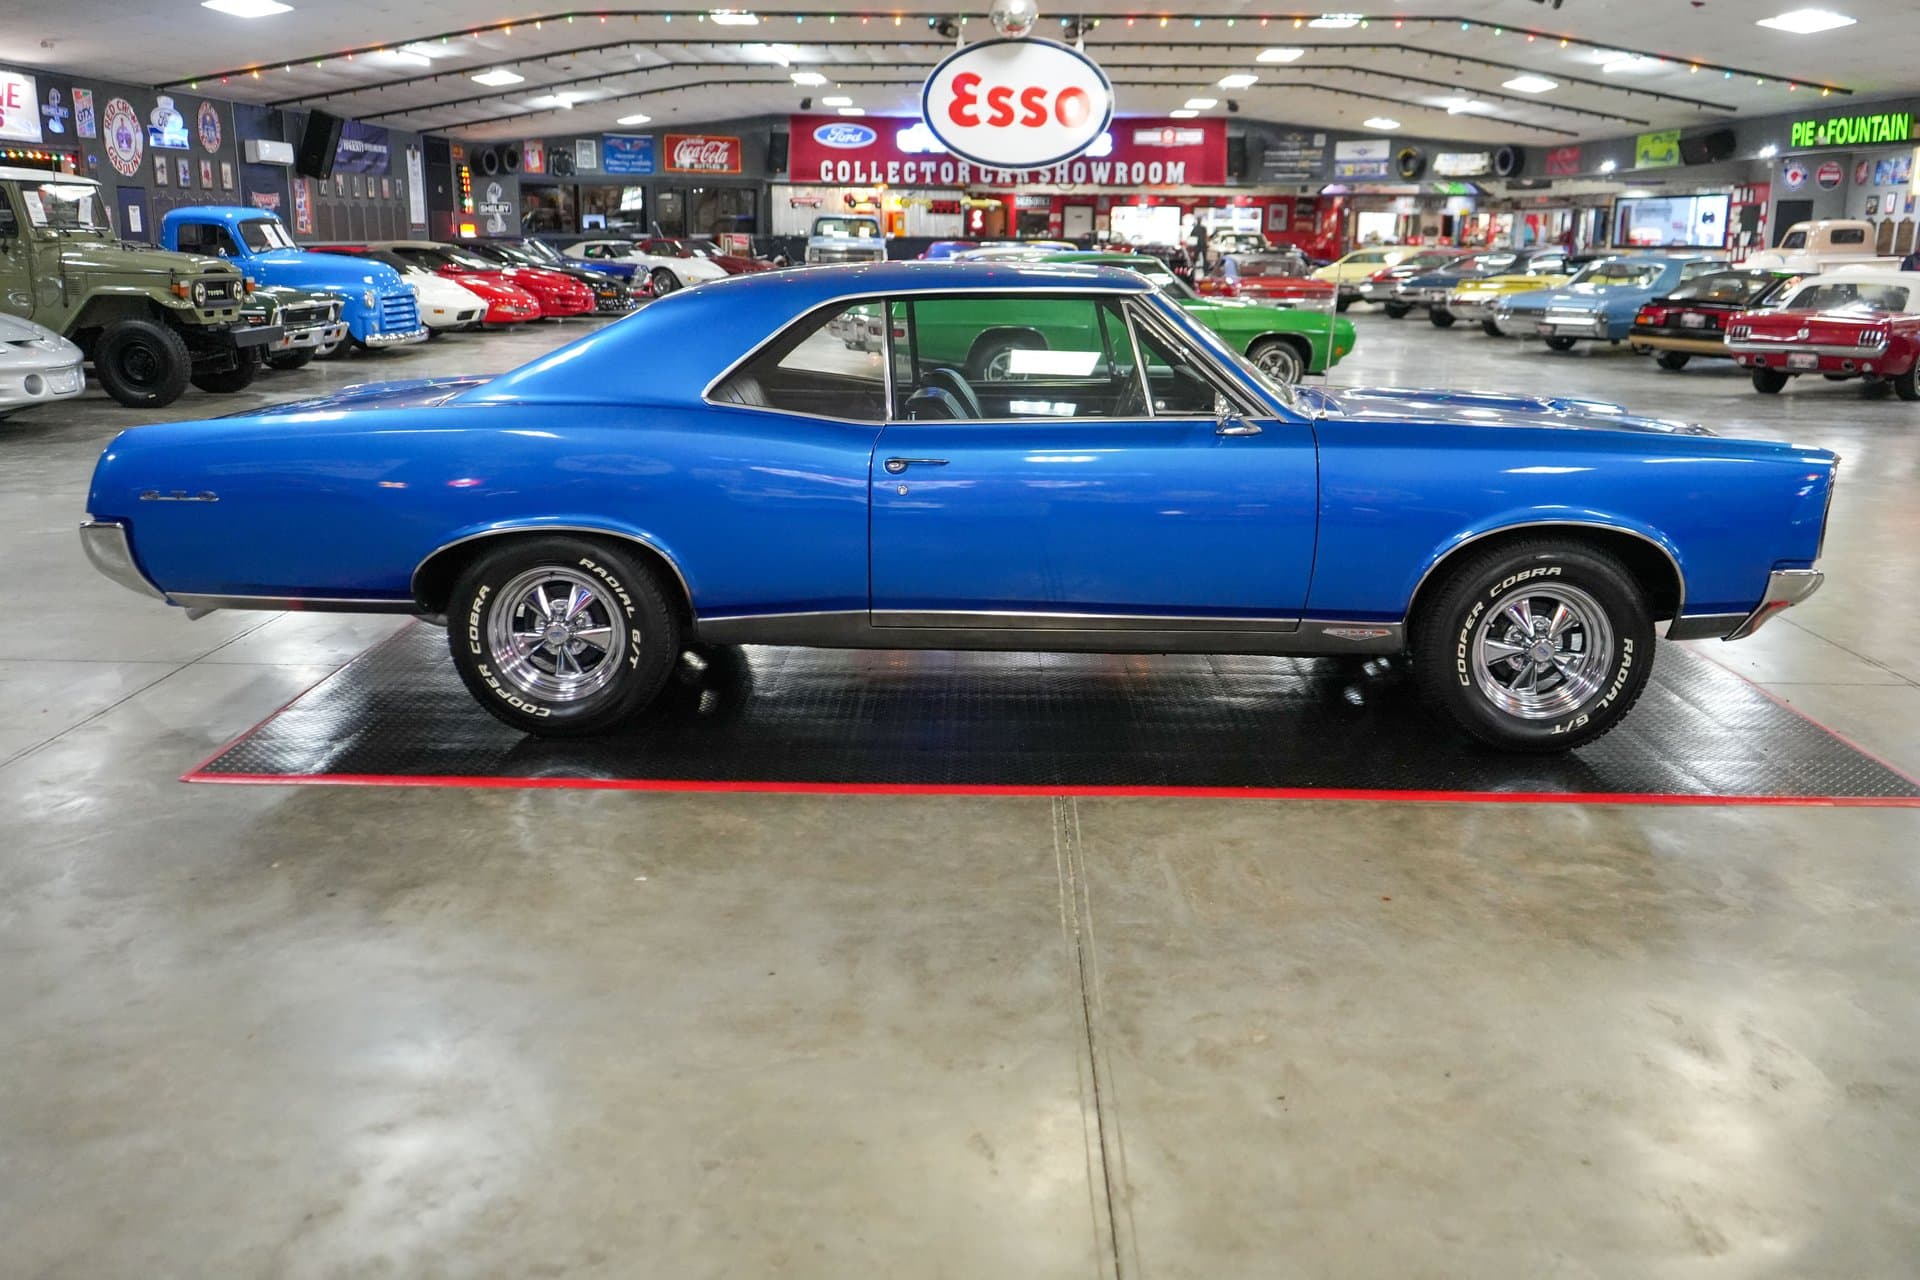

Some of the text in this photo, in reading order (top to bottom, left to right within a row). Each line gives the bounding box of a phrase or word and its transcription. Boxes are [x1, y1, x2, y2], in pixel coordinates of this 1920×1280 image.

[77, 106, 93, 121] GTX
[104, 104, 116, 129] RED
[1791, 112, 1909, 147] PIE FOUNTAIN
[108, 146, 141, 174] GASOLINE
[820, 160, 1186, 184] COLLECTOR CAR SHOWROOM
[480, 204, 511, 213] SHELBY
[578, 558, 642, 670] RADIAL G/T
[1456, 566, 1562, 687] COOPER COBRA
[468, 585, 552, 718] COOPER COBRA
[1551, 637, 1634, 735] RADIAL G/T
